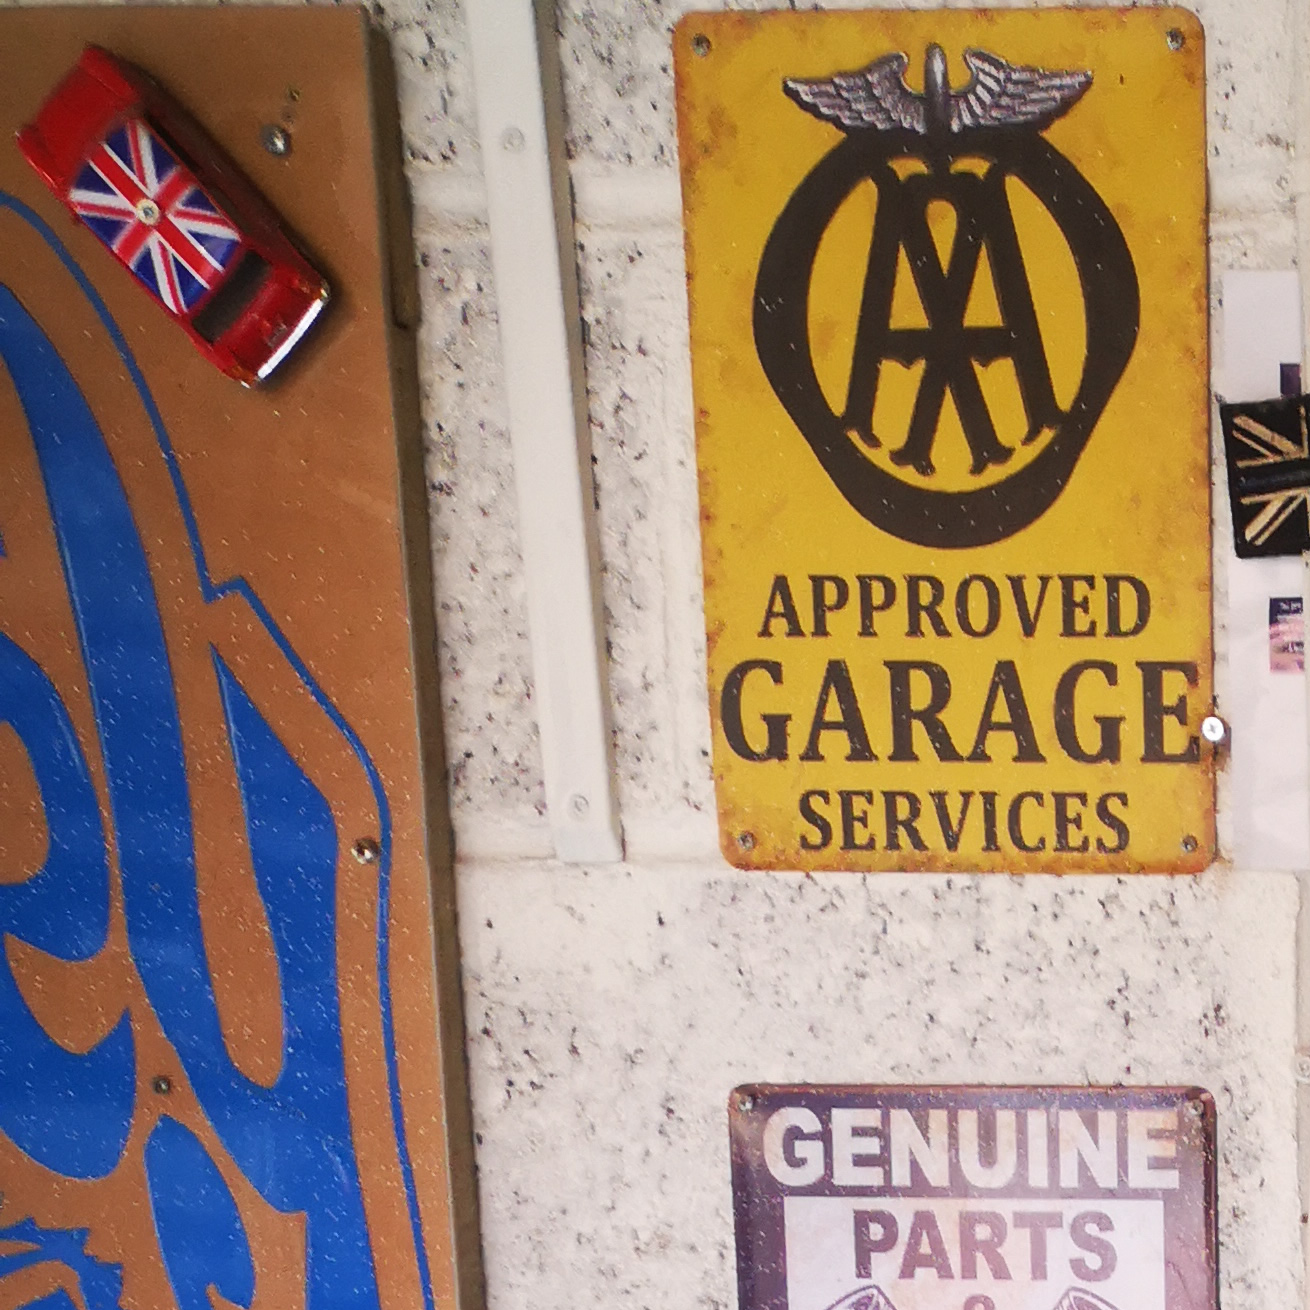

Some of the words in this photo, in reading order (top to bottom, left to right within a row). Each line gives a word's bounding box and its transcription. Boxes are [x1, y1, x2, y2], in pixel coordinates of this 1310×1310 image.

[757, 573, 1151, 639] APPROVED
[719, 658, 1201, 764] GARAGE
[799, 789, 1131, 854] SERVICES
[762, 1105, 1180, 1190] GENUINE
[852, 1208, 1118, 1283] PARTS
